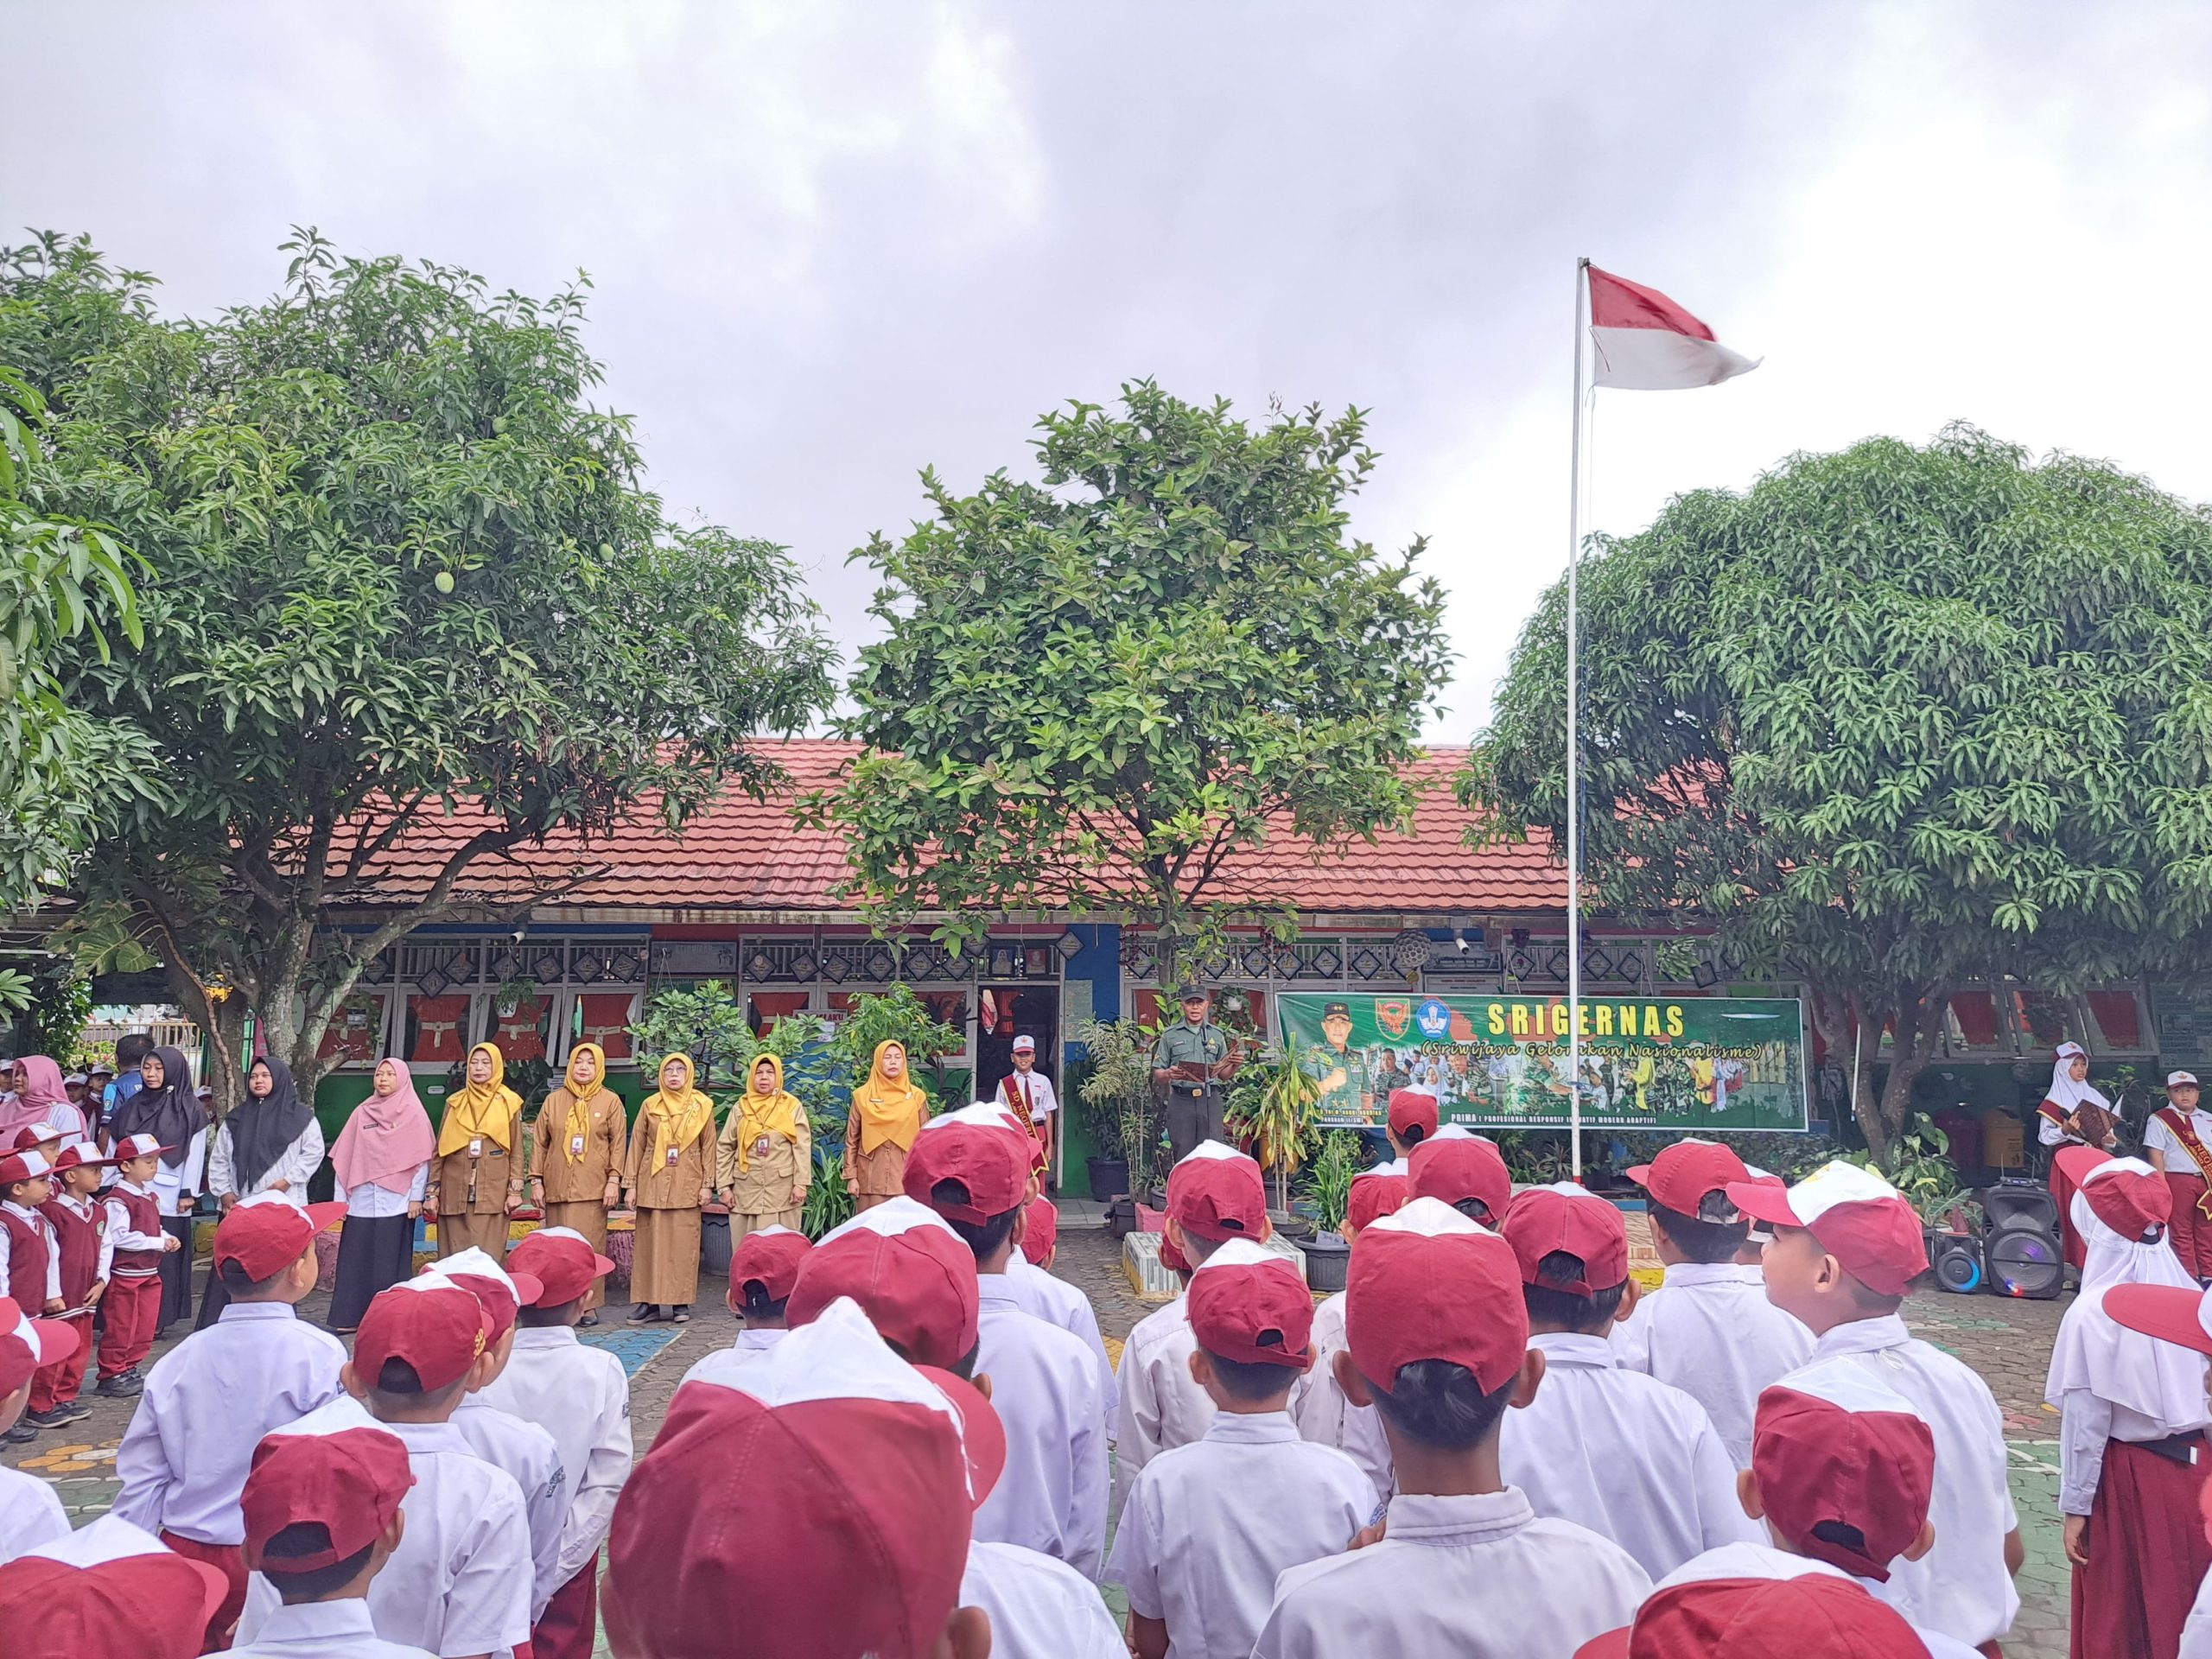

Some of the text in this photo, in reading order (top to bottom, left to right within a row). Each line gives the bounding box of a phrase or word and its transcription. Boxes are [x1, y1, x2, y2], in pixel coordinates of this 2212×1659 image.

[1487, 1003, 1684, 1037] SRIGERNAS
[1421, 1040, 1521, 1059] (Sriwijaya
[1628, 1043, 1764, 1060] Nasionalisme)
[1451, 1113, 1477, 1122] PRIMA
